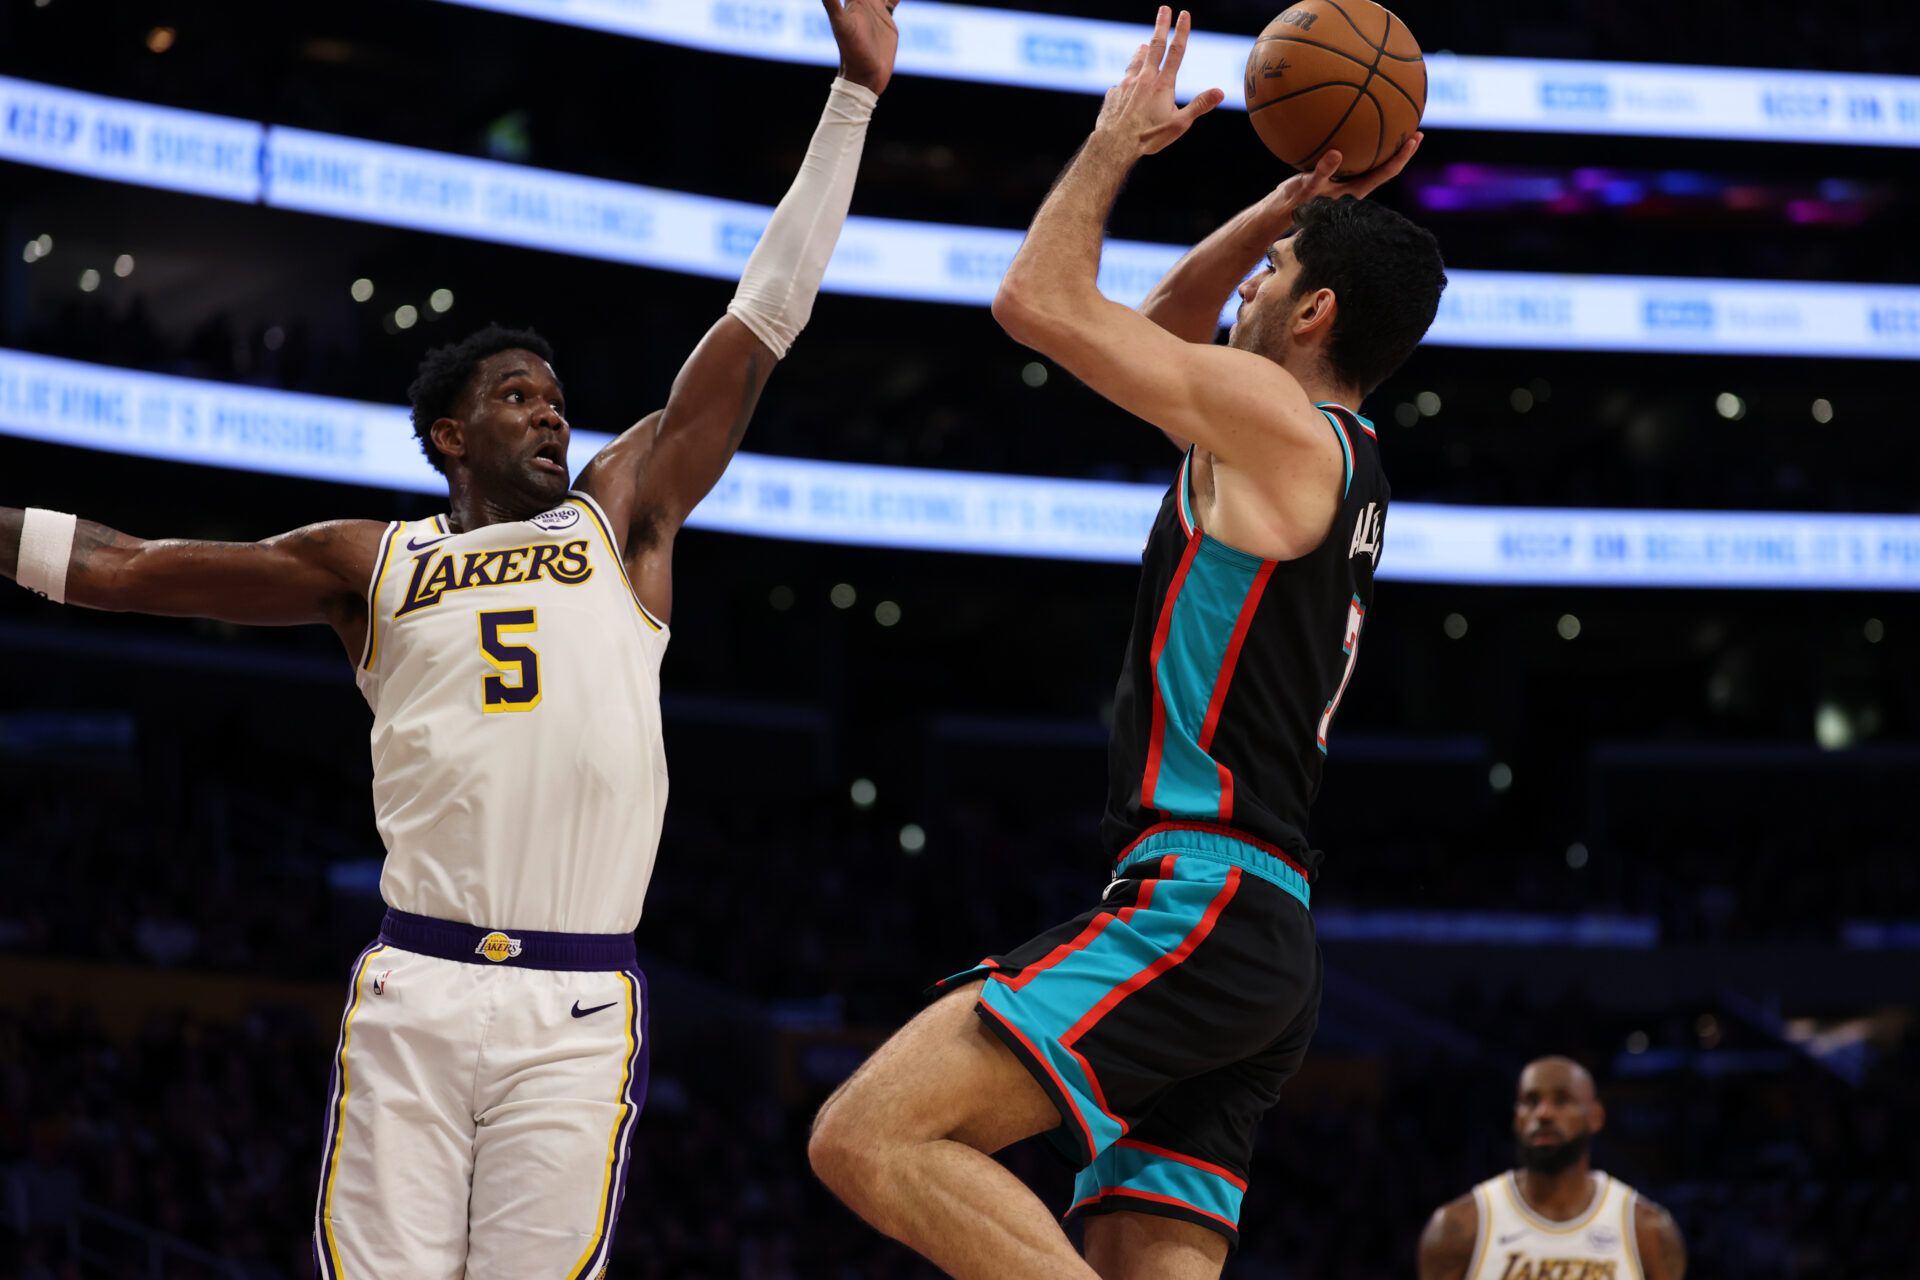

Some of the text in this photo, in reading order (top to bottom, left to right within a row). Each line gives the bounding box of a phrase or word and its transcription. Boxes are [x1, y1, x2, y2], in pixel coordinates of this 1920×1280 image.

[393, 539, 593, 621] LAKERS
[477, 607, 542, 713] 5
[476, 938, 520, 956] LAKERS
